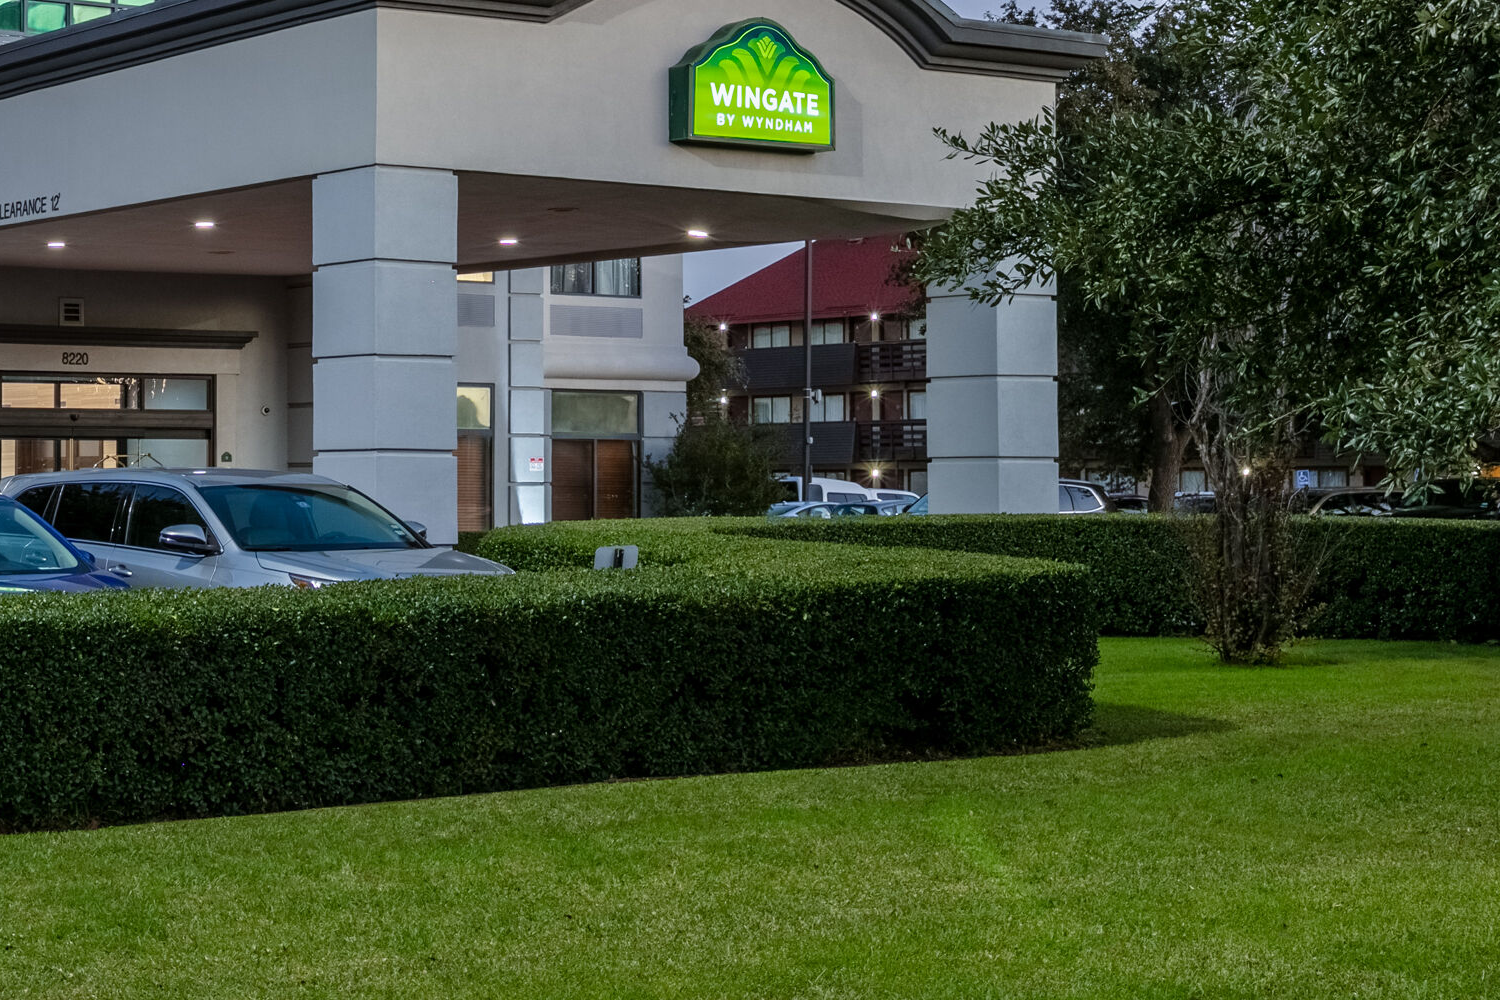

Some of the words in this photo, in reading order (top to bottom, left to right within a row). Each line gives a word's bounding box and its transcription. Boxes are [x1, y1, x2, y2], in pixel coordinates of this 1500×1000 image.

[710, 82, 819, 116] WINGATE
[716, 112, 735, 127] BY
[742, 115, 813, 134] WYNDHAM
[50, 192, 61, 212] 12'
[62, 351, 89, 365] 8220
